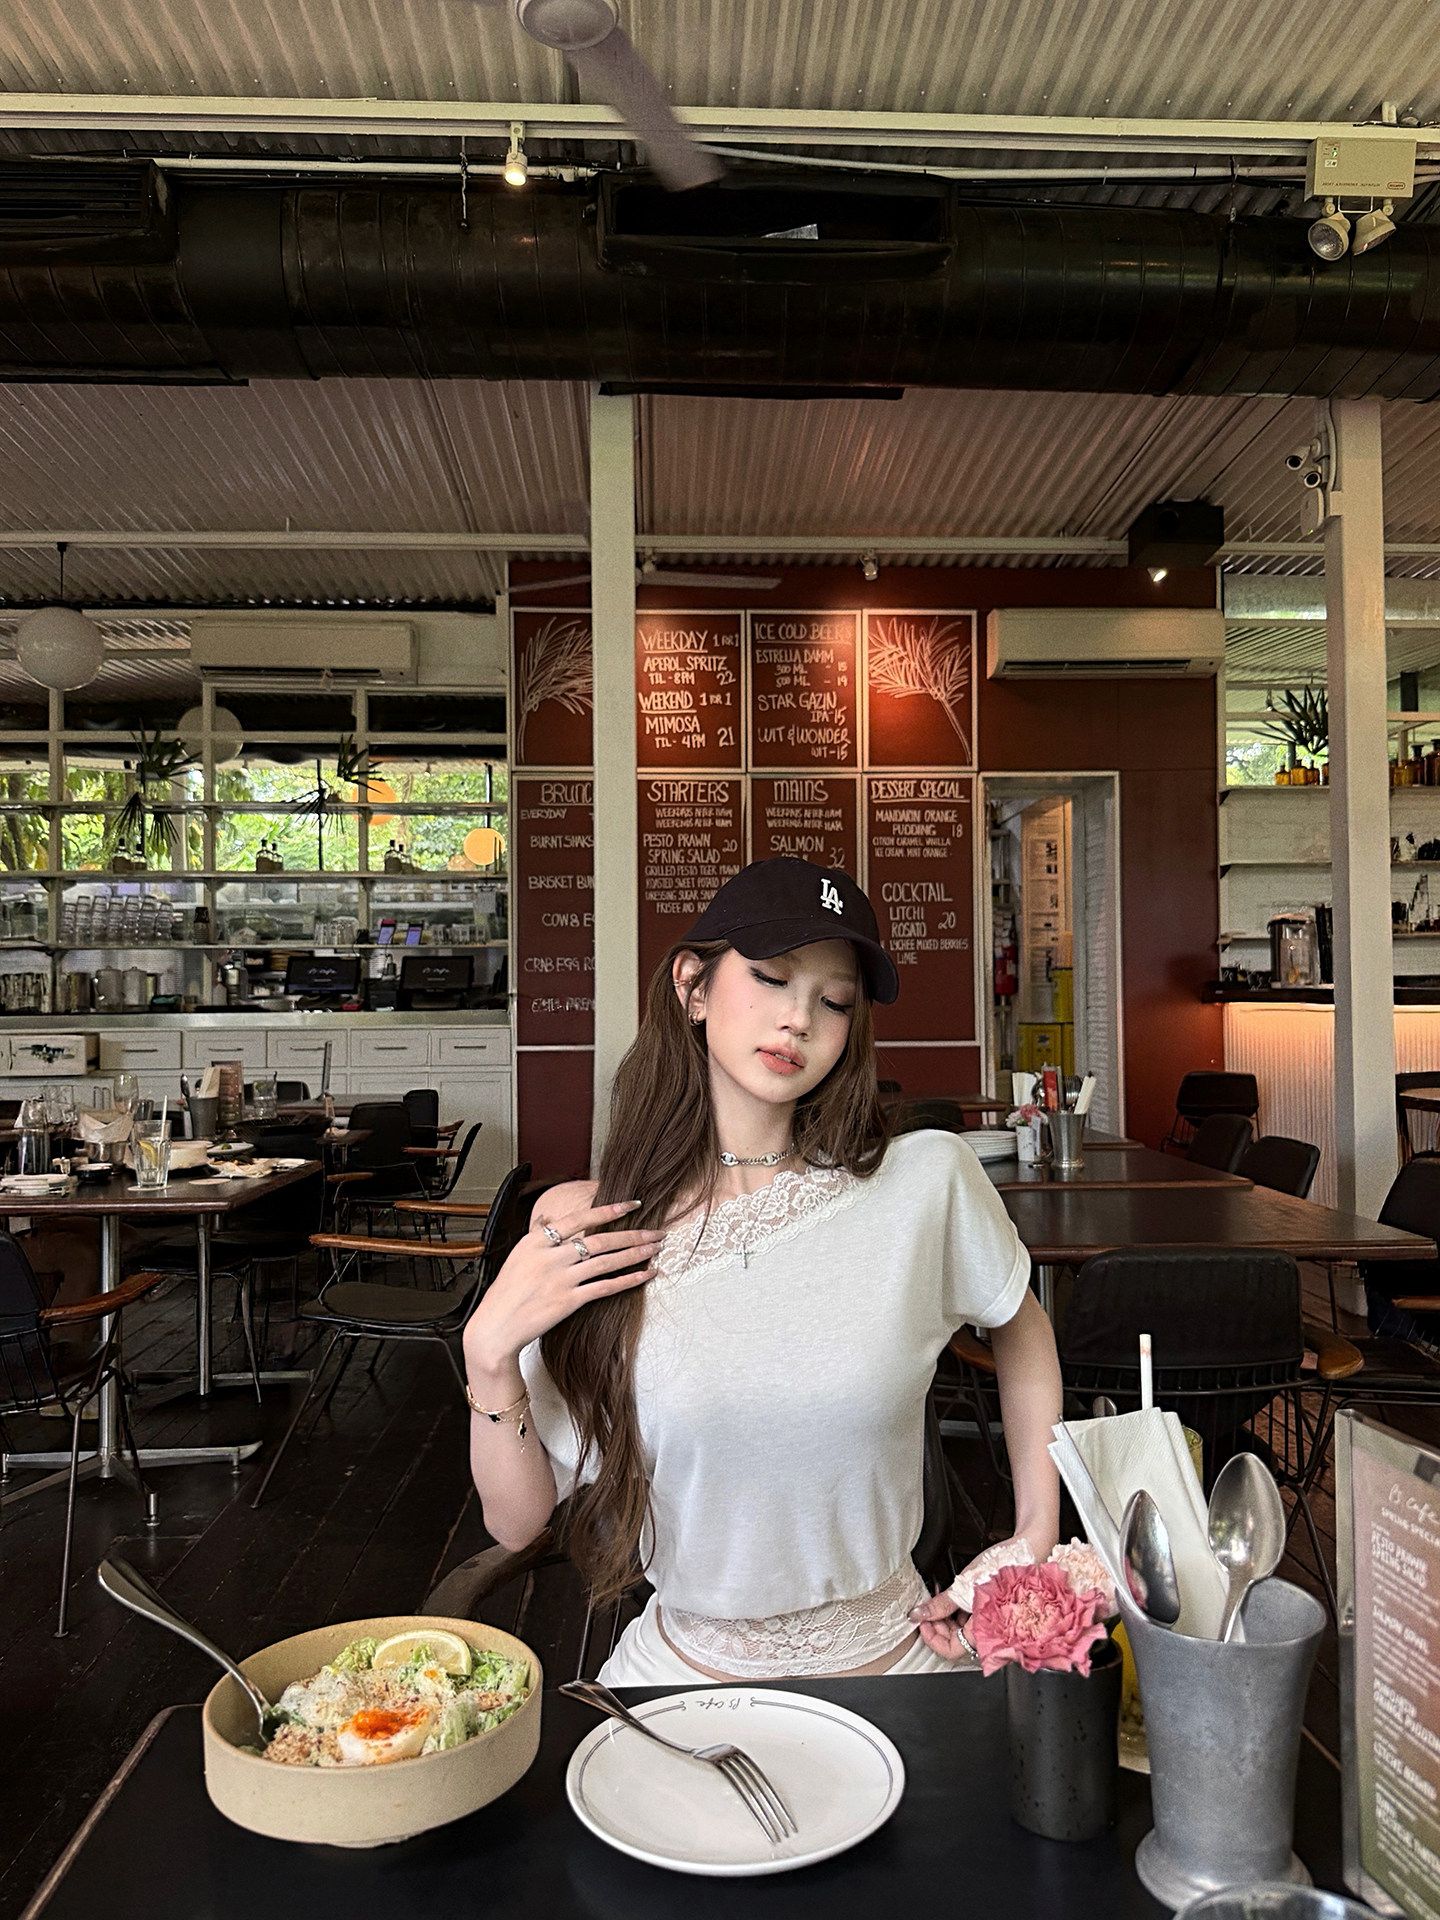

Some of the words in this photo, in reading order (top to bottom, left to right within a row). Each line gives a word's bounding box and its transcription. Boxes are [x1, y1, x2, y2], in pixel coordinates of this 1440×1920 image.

[639, 630, 708, 650] WEEKDAY
[754, 623, 776, 640] ICE
[778, 623, 807, 640] COLD
[643, 656, 685, 672] APEROL
[685, 655, 727, 671] SPRITZ
[755, 649, 801, 664] ESTRELLA
[716, 670, 736, 686] 22
[793, 675, 811, 687] ML
[638, 690, 693, 710] WEEKEND
[700, 692, 708, 706] 1
[725, 692, 732, 706] 1
[757, 692, 796, 711] STAR
[799, 691, 837, 711] GAZIN
[645, 715, 700, 735] MIMOSA
[717, 726, 735, 747] 21
[757, 726, 785, 743] WIT
[647, 781, 729, 803] STARTERS
[773, 780, 829, 802] MAINS
[871, 780, 917, 799] DESSERT
[917, 780, 965, 799] SPECIAL
[521, 808, 567, 820] EVERYDAY
[875, 809, 921, 822] MANDARIN
[924, 809, 958, 823] ORANGE
[892, 824, 937, 836] PUDDING
[951, 824, 963, 838] 18
[530, 835, 563, 849] BURNT
[643, 833, 674, 847] PESTO
[677, 833, 711, 847] PRAWN
[721, 839, 738, 853] 20
[770, 835, 824, 852] SALMON
[648, 848, 685, 864] SPRING
[686, 848, 721, 864] SALAD
[826, 847, 845, 869] 32
[528, 875, 574, 889] BRISKET
[820, 878, 843, 915] LA
[882, 882, 954, 903] COCKTAIL
[583, 913, 595, 927] E
[889, 905, 924, 921] LITCHI
[938, 911, 956, 930] 20
[891, 921, 927, 938] ROSATO
